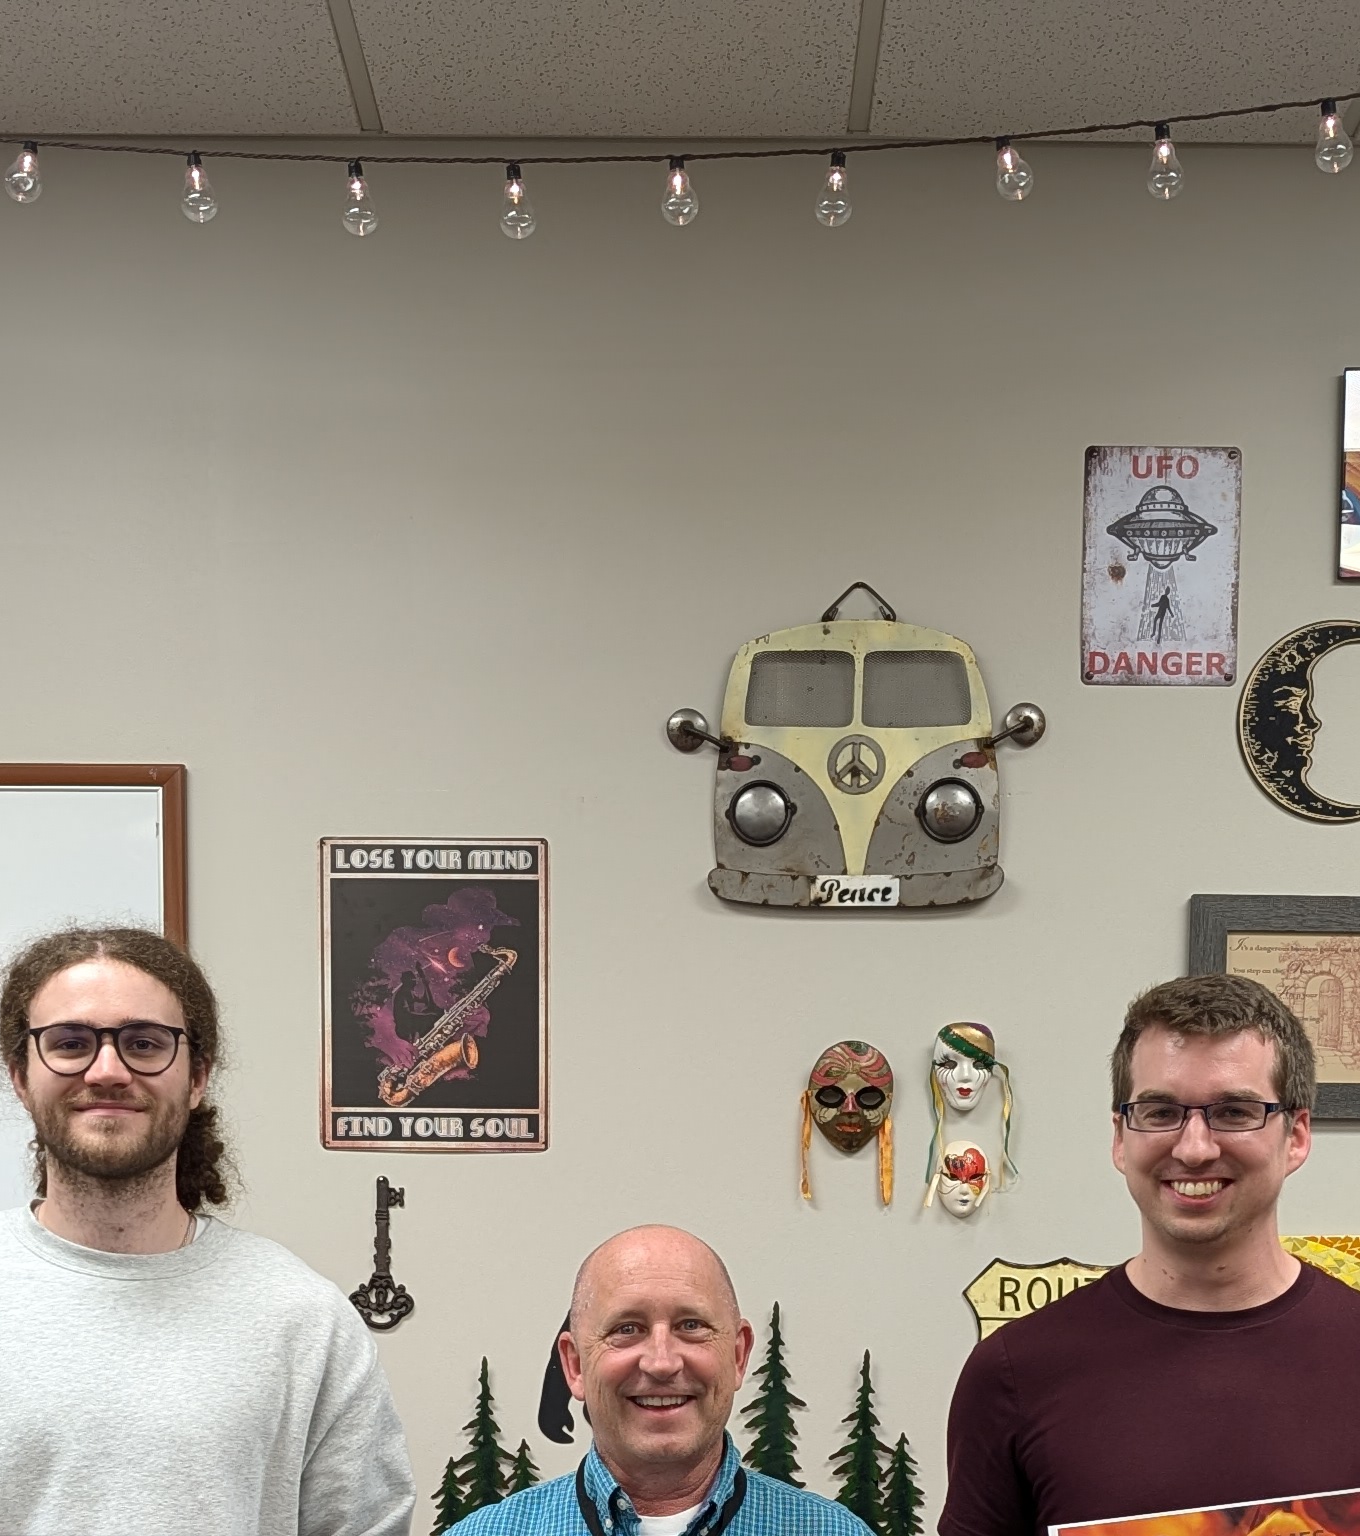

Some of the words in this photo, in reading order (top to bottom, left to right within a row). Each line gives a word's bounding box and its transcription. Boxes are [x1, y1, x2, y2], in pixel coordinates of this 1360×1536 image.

[1131, 455, 1200, 479] UFO
[1088, 652, 1225, 676] DANGER
[335, 848, 395, 869] LOSE
[400, 849, 462, 870] YOUR
[467, 850, 533, 870] MIND
[336, 1116, 392, 1137] FIND
[399, 1117, 463, 1138] YOUR
[469, 1118, 534, 1138] SOUL
